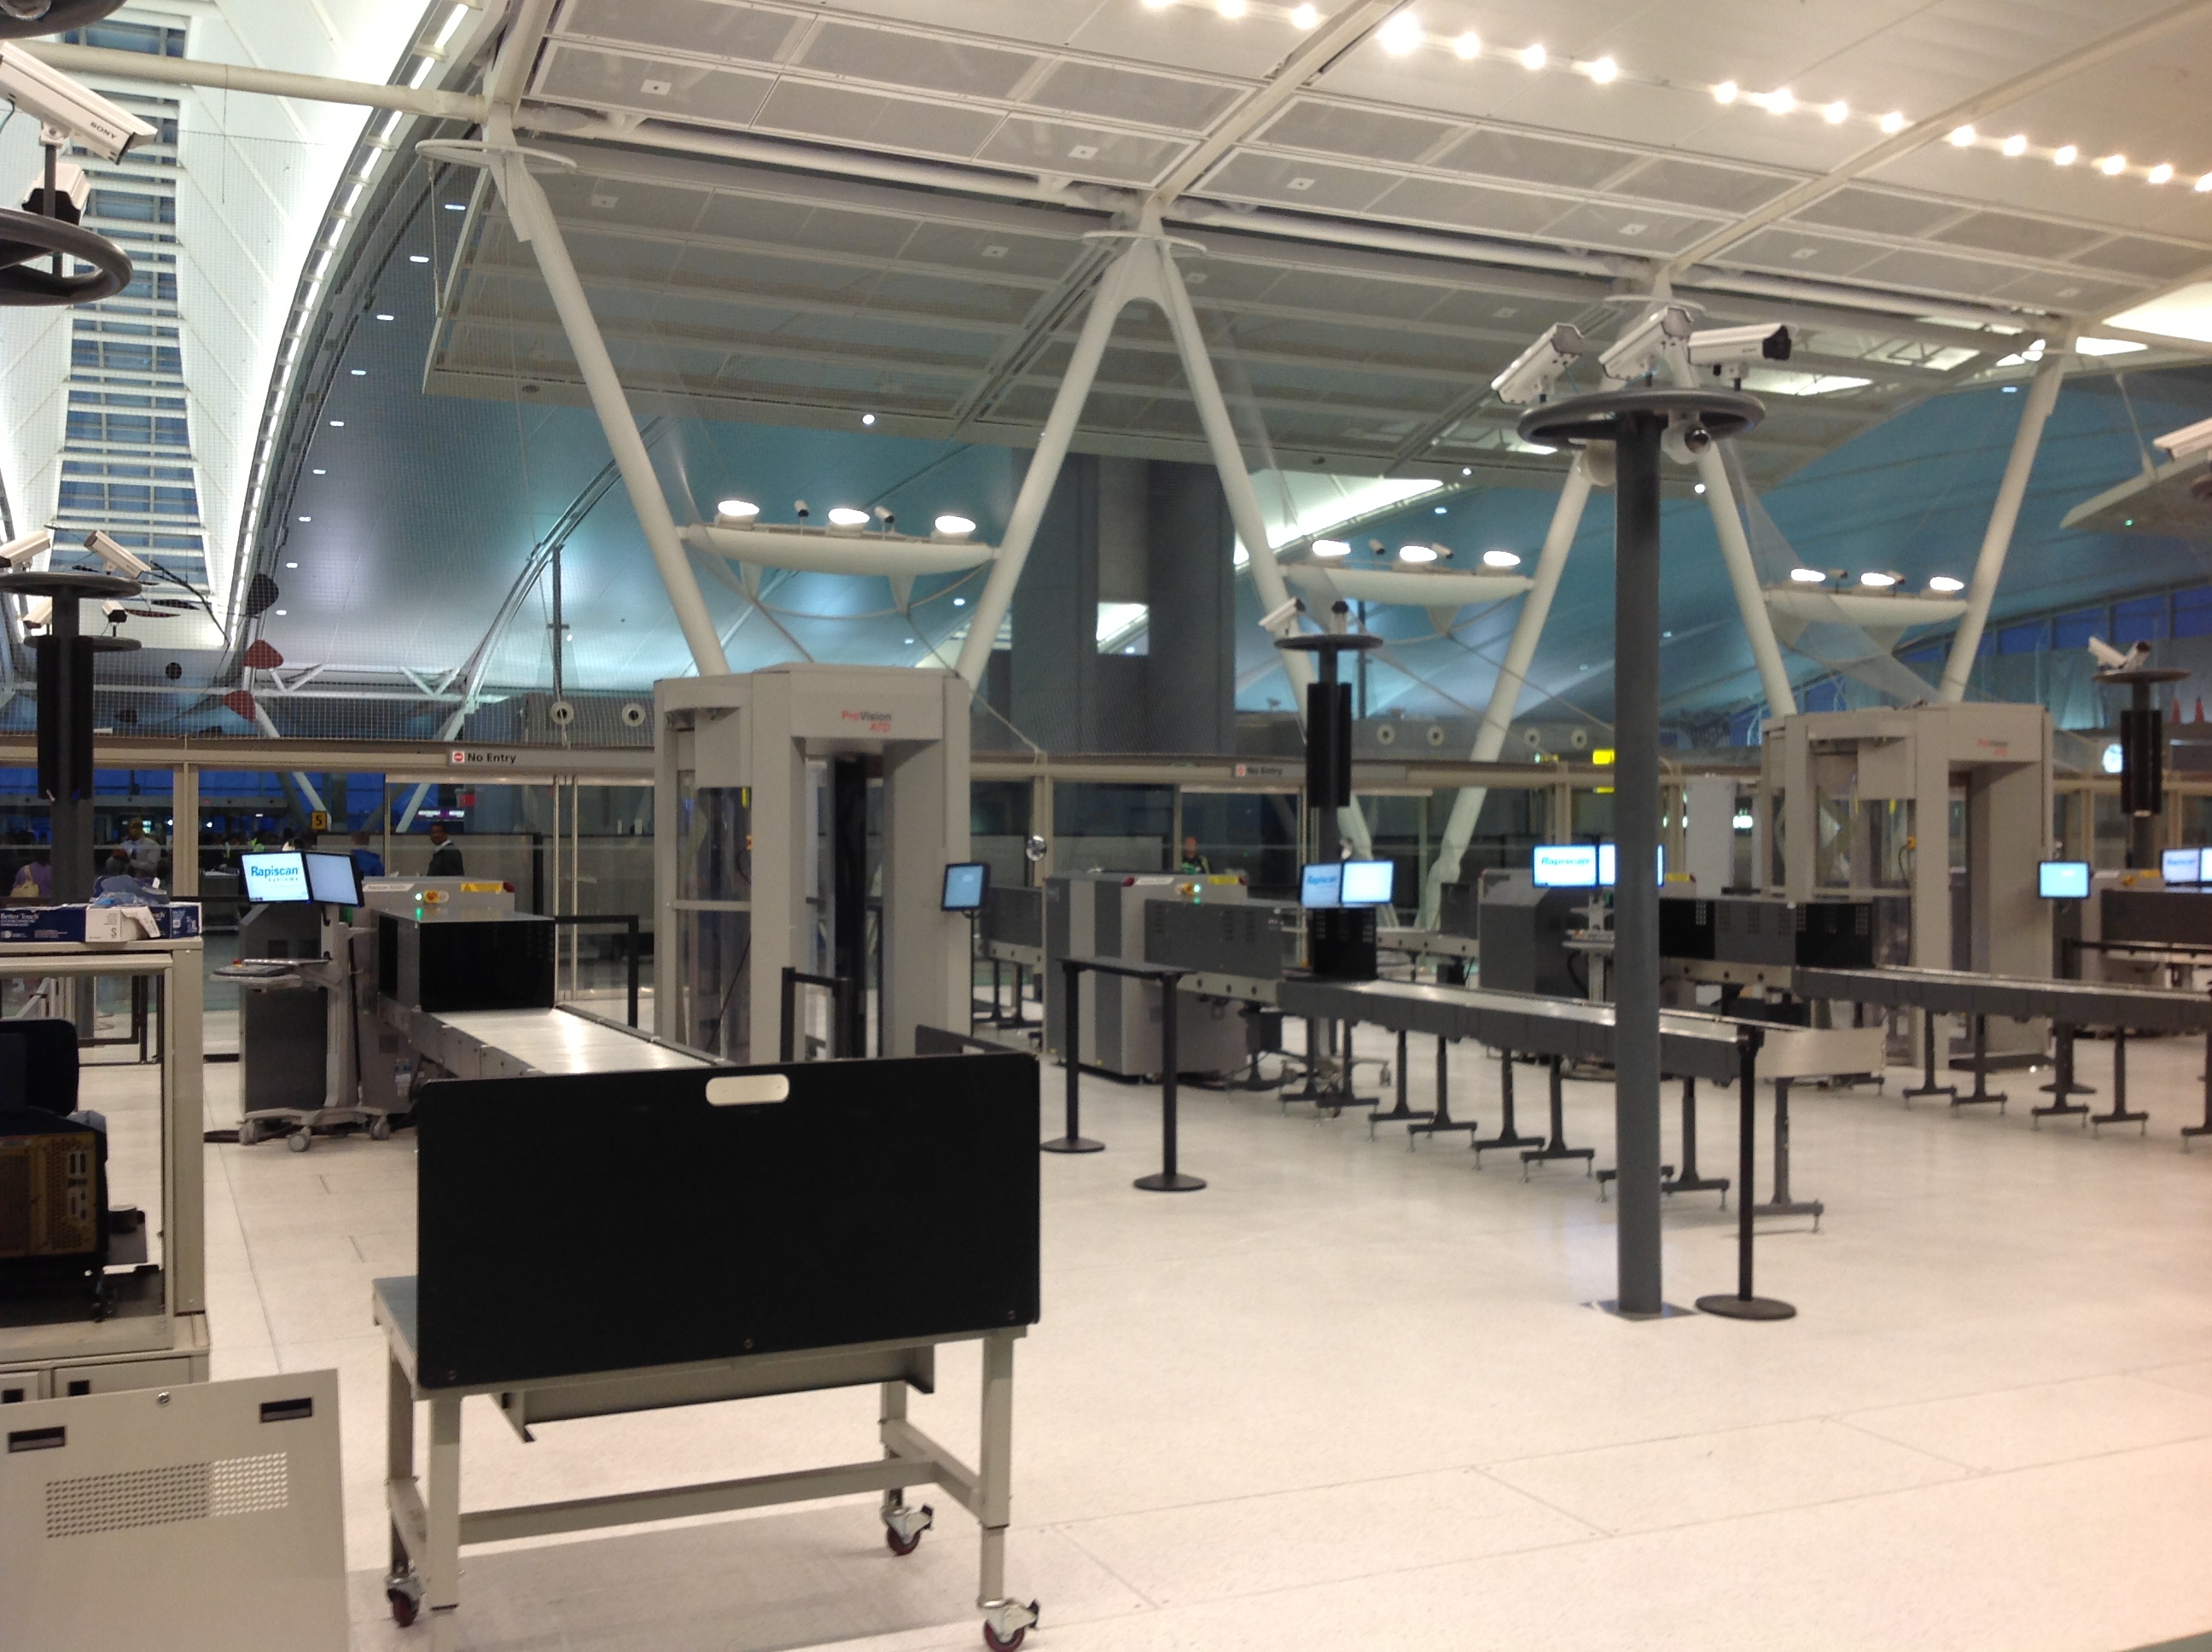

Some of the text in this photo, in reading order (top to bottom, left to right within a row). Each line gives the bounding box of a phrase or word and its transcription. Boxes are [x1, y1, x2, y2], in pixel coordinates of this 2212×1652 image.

[90, 121, 117, 140] SONY
[841, 710, 892, 722] ProVision
[468, 753, 516, 764] No Entry
[251, 864, 299, 879] Rapiscan
[111, 928, 118, 938] S
